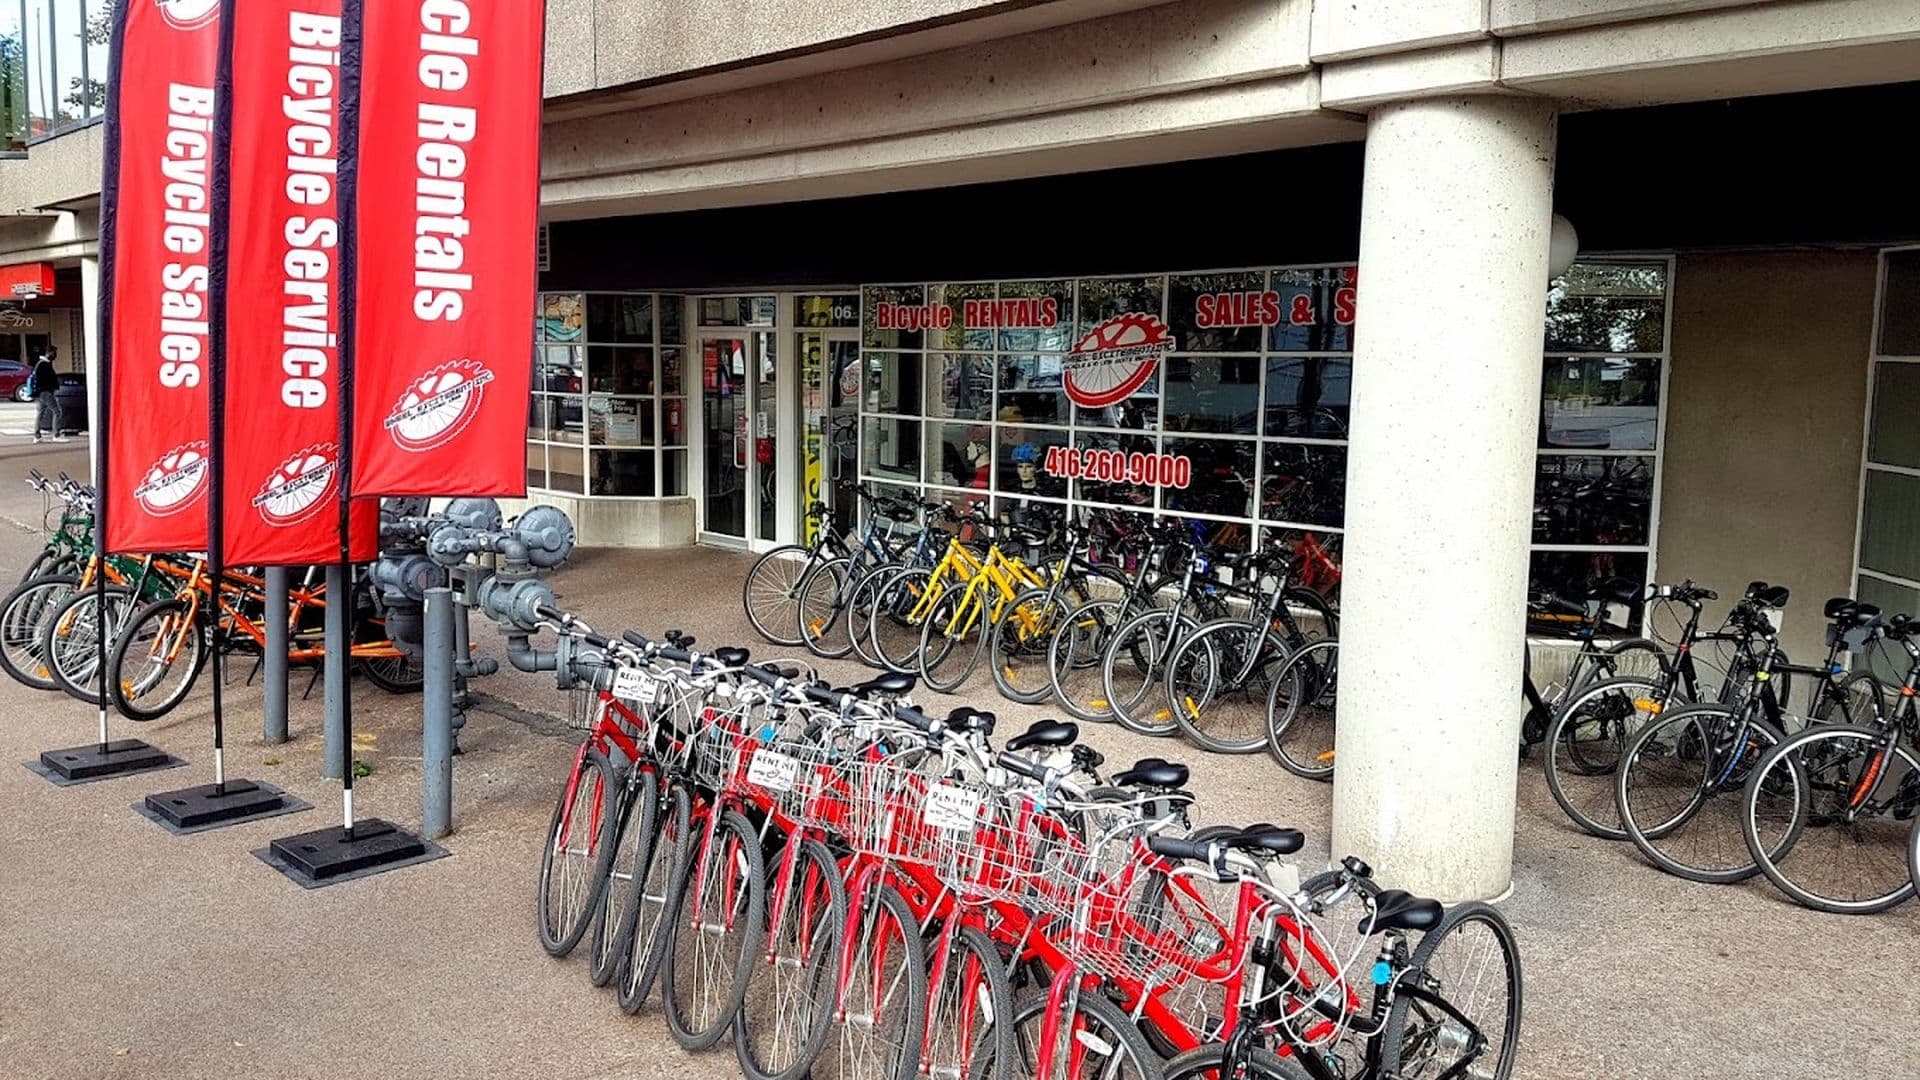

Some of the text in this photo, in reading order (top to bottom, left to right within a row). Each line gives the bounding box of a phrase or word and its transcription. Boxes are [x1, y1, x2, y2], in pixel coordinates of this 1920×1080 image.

[282, 11, 341, 206] Bicycle
[159, 83, 215, 388] Bicycle Sales
[413, 102, 477, 322] Rentals
[281, 216, 338, 409] Service
[829, 305, 852, 320] 106
[876, 298, 1057, 332] Bicycle RENTALS
[1196, 289, 1280, 328] SALES
[1290, 294, 1316, 325] &
[1044, 446, 1190, 489] 416.260.9000
